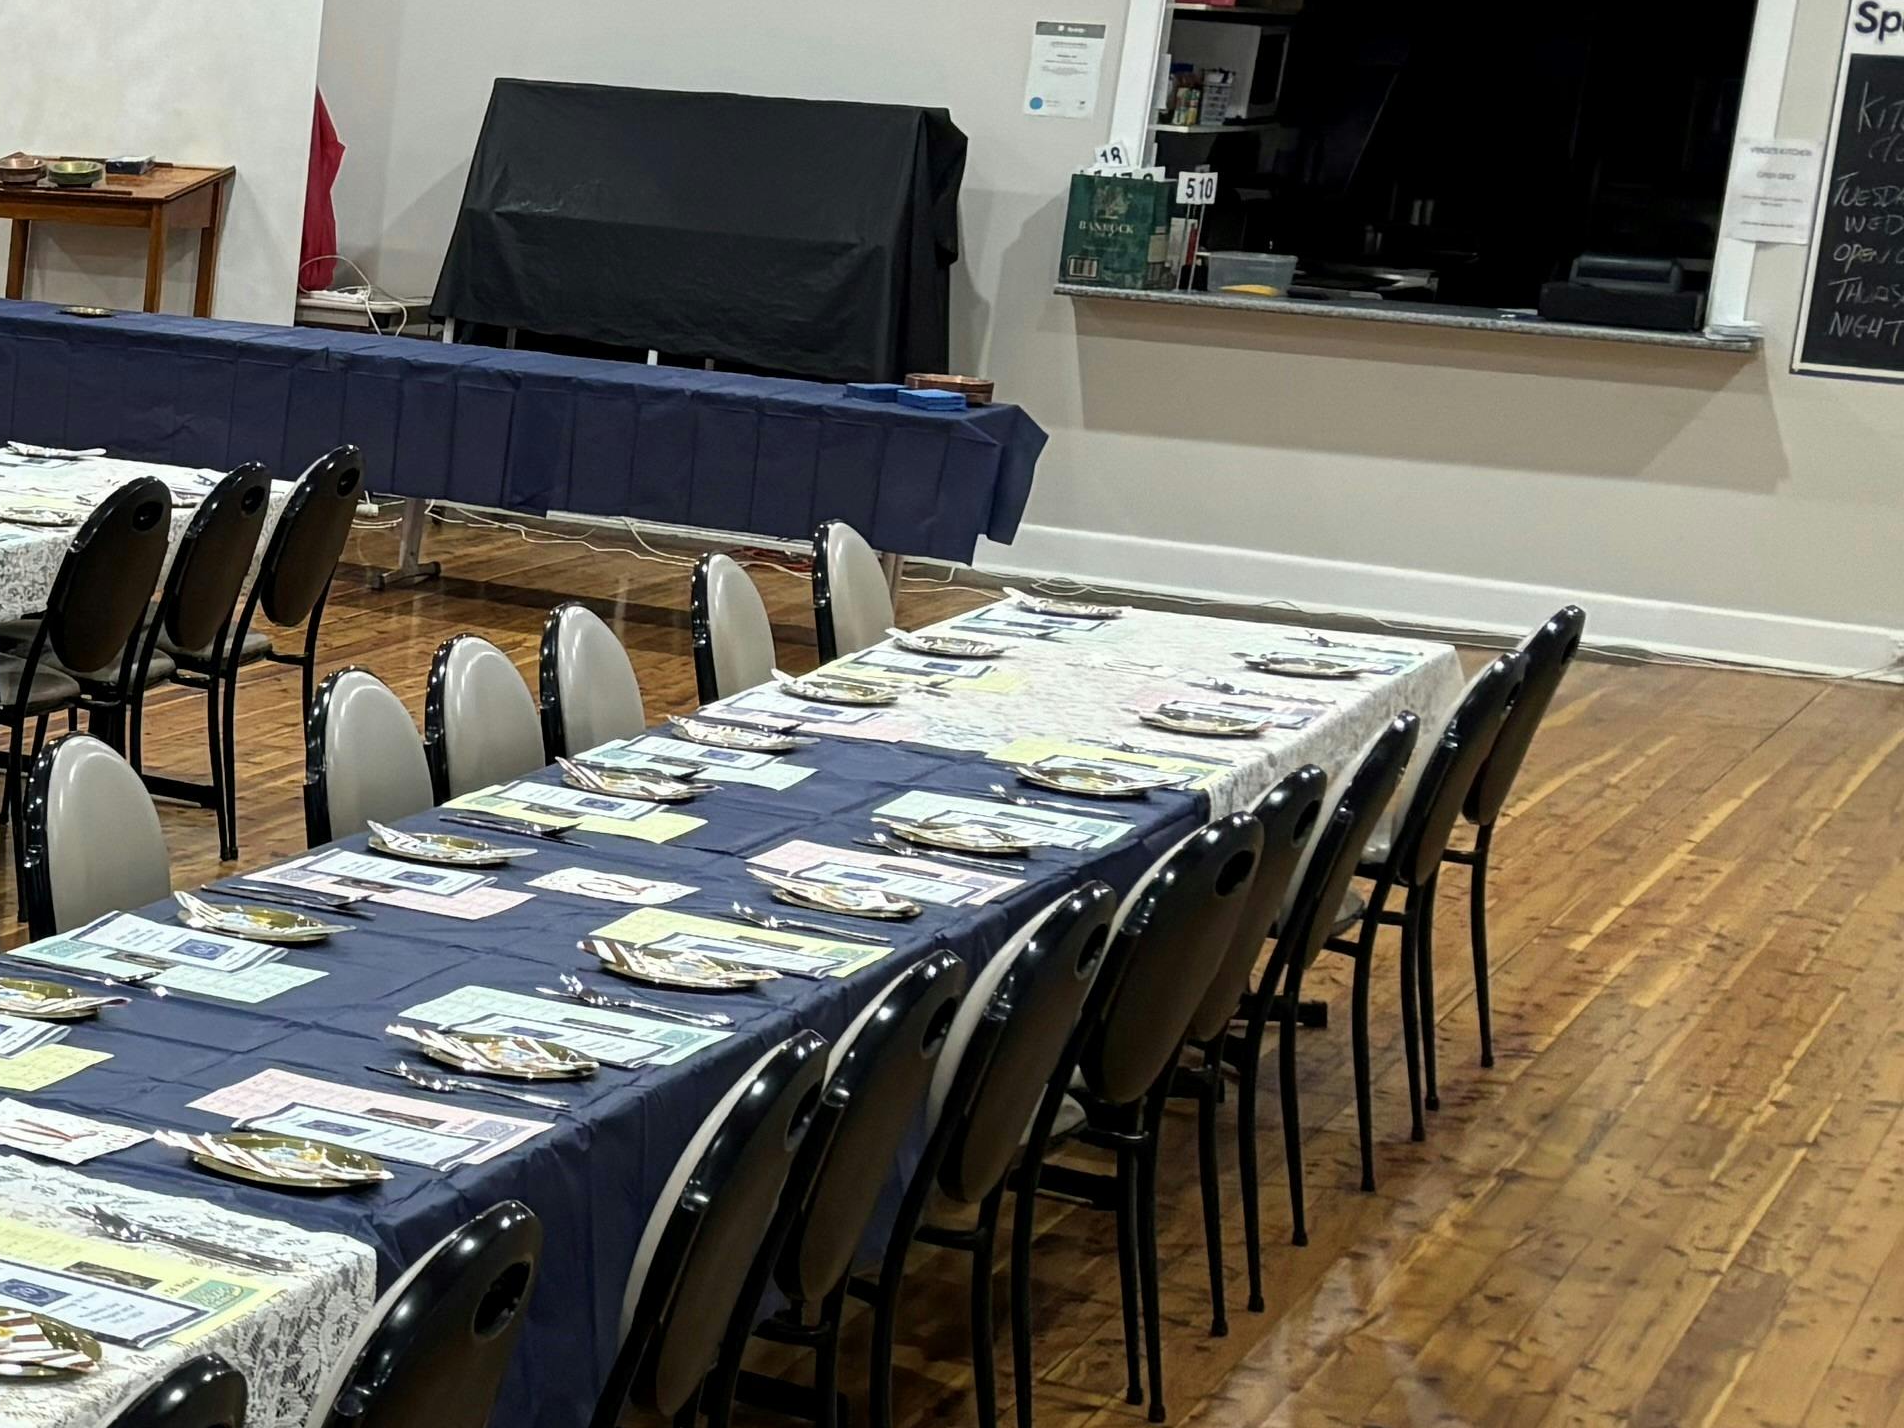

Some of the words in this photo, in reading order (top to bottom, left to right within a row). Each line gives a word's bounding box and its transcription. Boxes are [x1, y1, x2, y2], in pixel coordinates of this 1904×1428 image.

[1854, 1, 1904, 41] Sp
[1857, 82, 1904, 133] KIT
[1099, 146, 1123, 165] 18
[1199, 177, 1214, 200] 10
